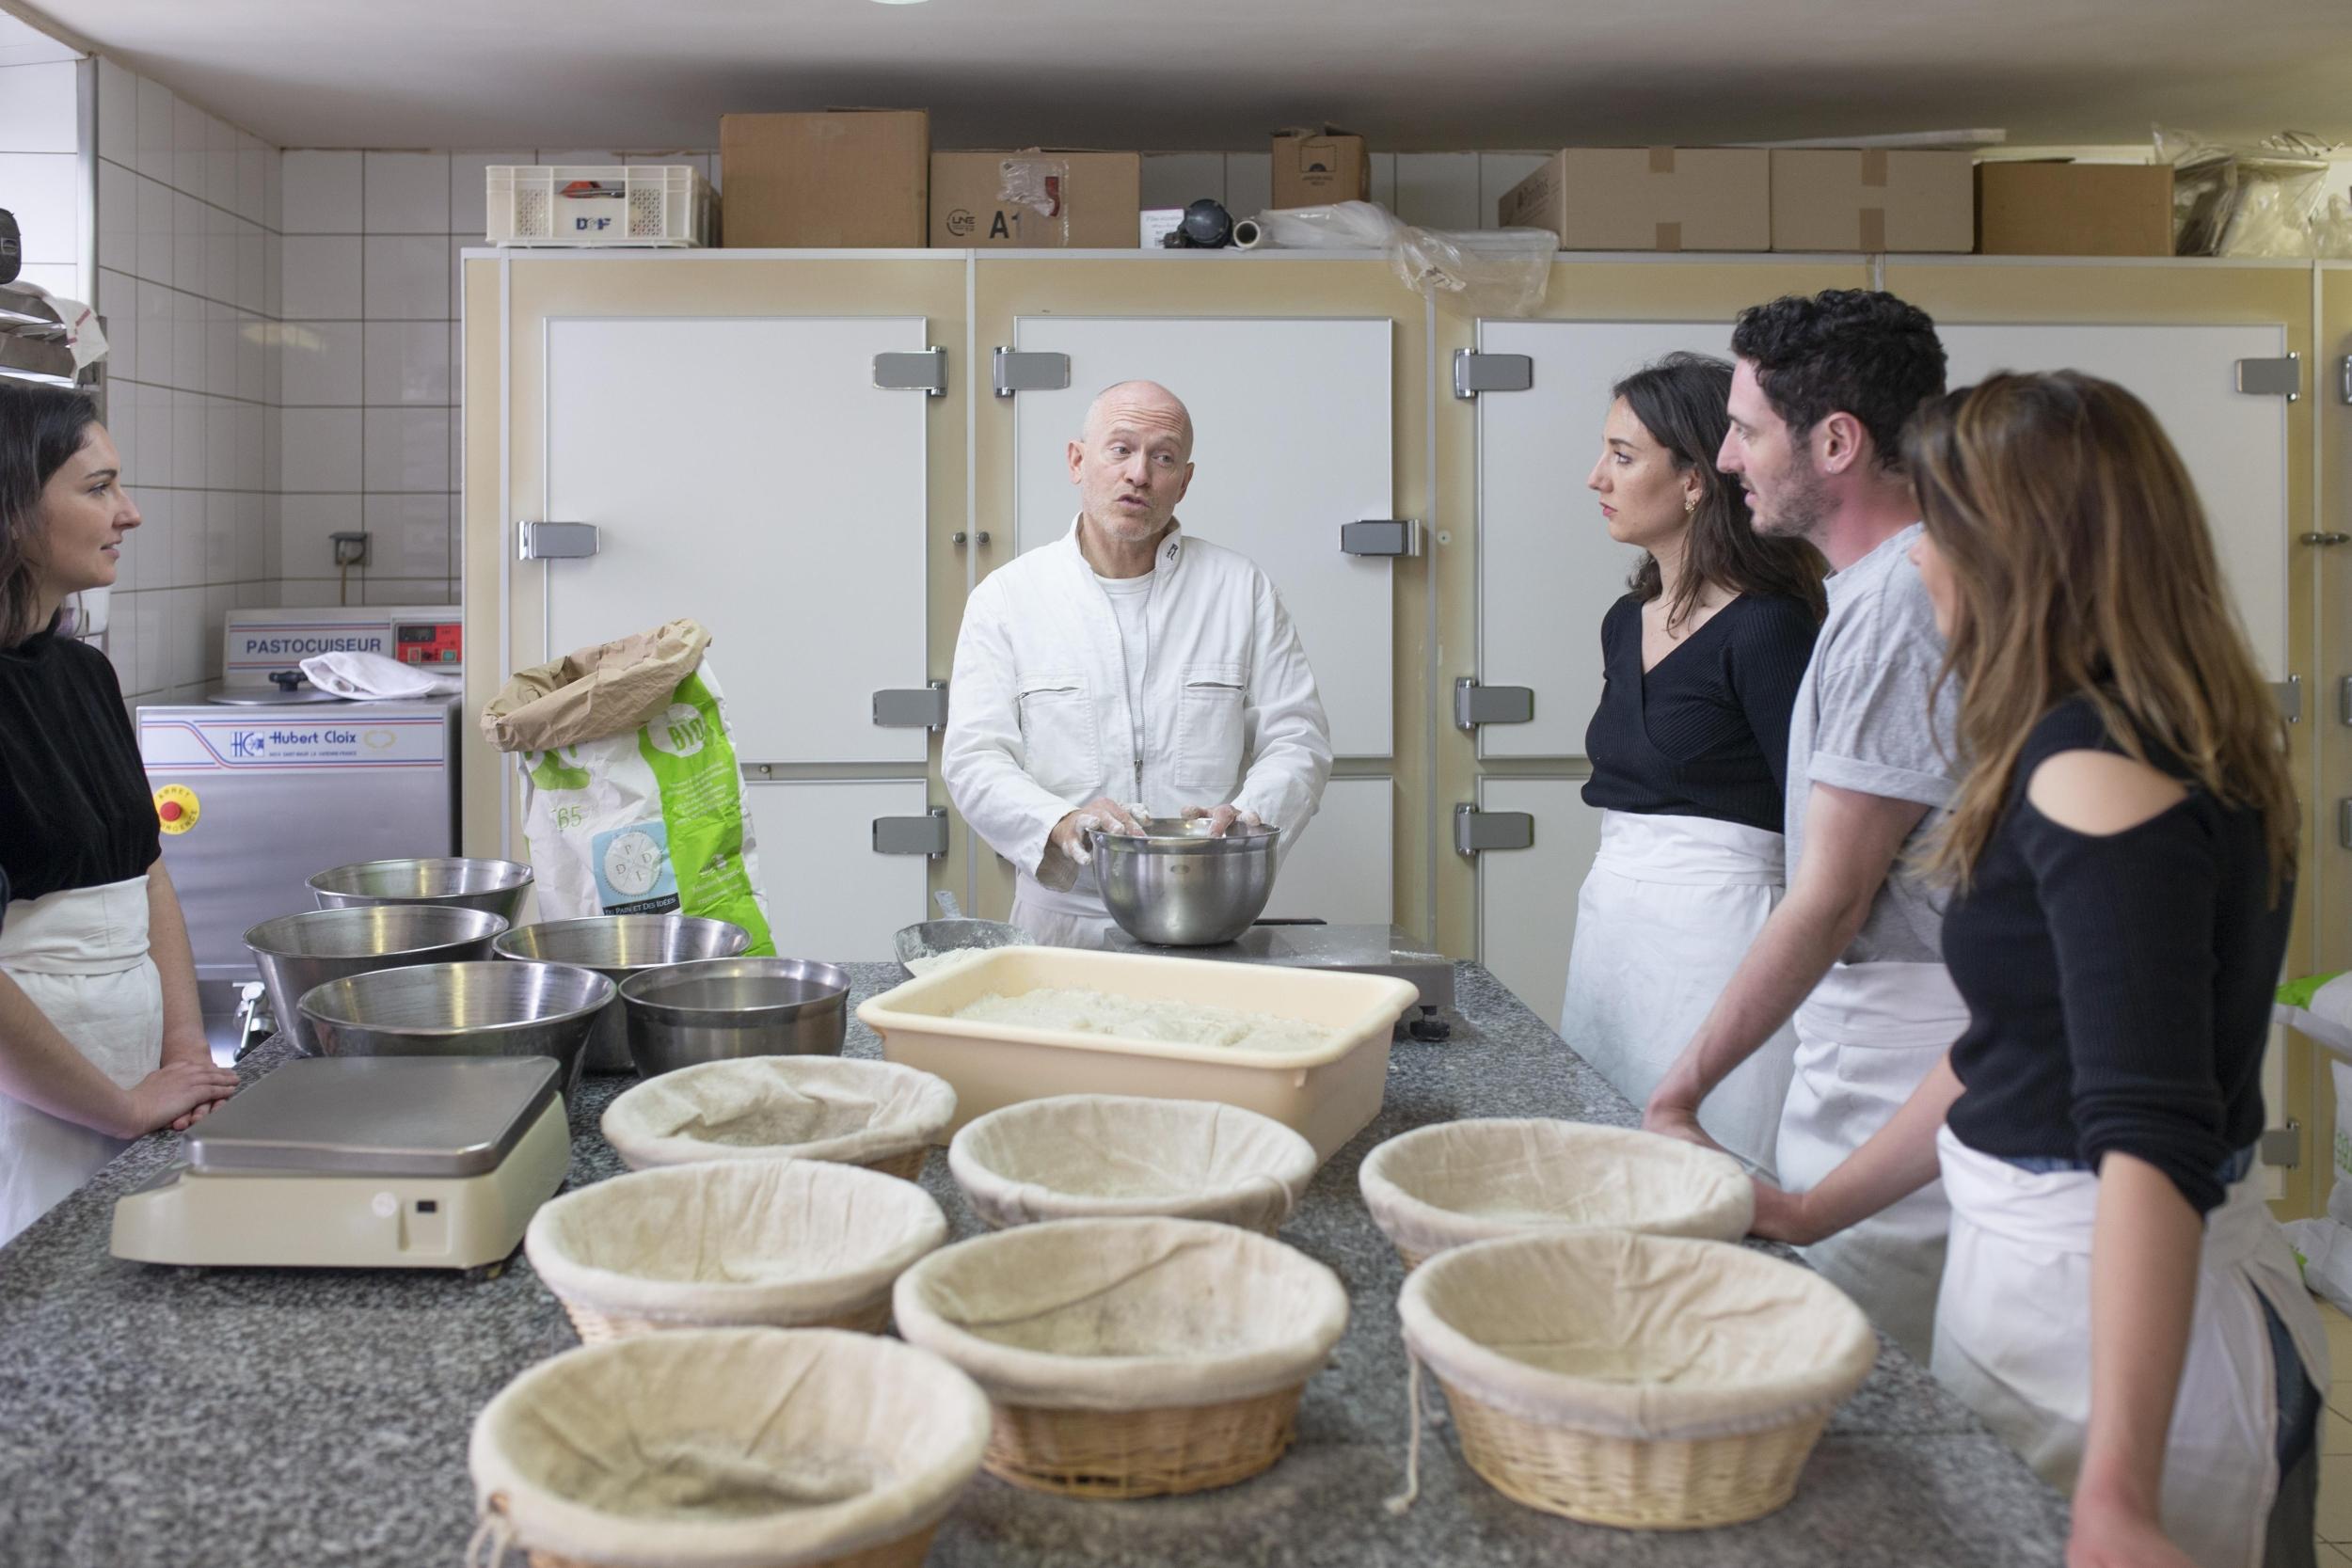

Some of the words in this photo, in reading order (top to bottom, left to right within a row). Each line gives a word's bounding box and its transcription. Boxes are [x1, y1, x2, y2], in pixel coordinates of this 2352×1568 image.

[246, 638, 382, 654] PASTOCUISEUR
[269, 731, 319, 744] Hubert
[324, 731, 357, 744] Cloix
